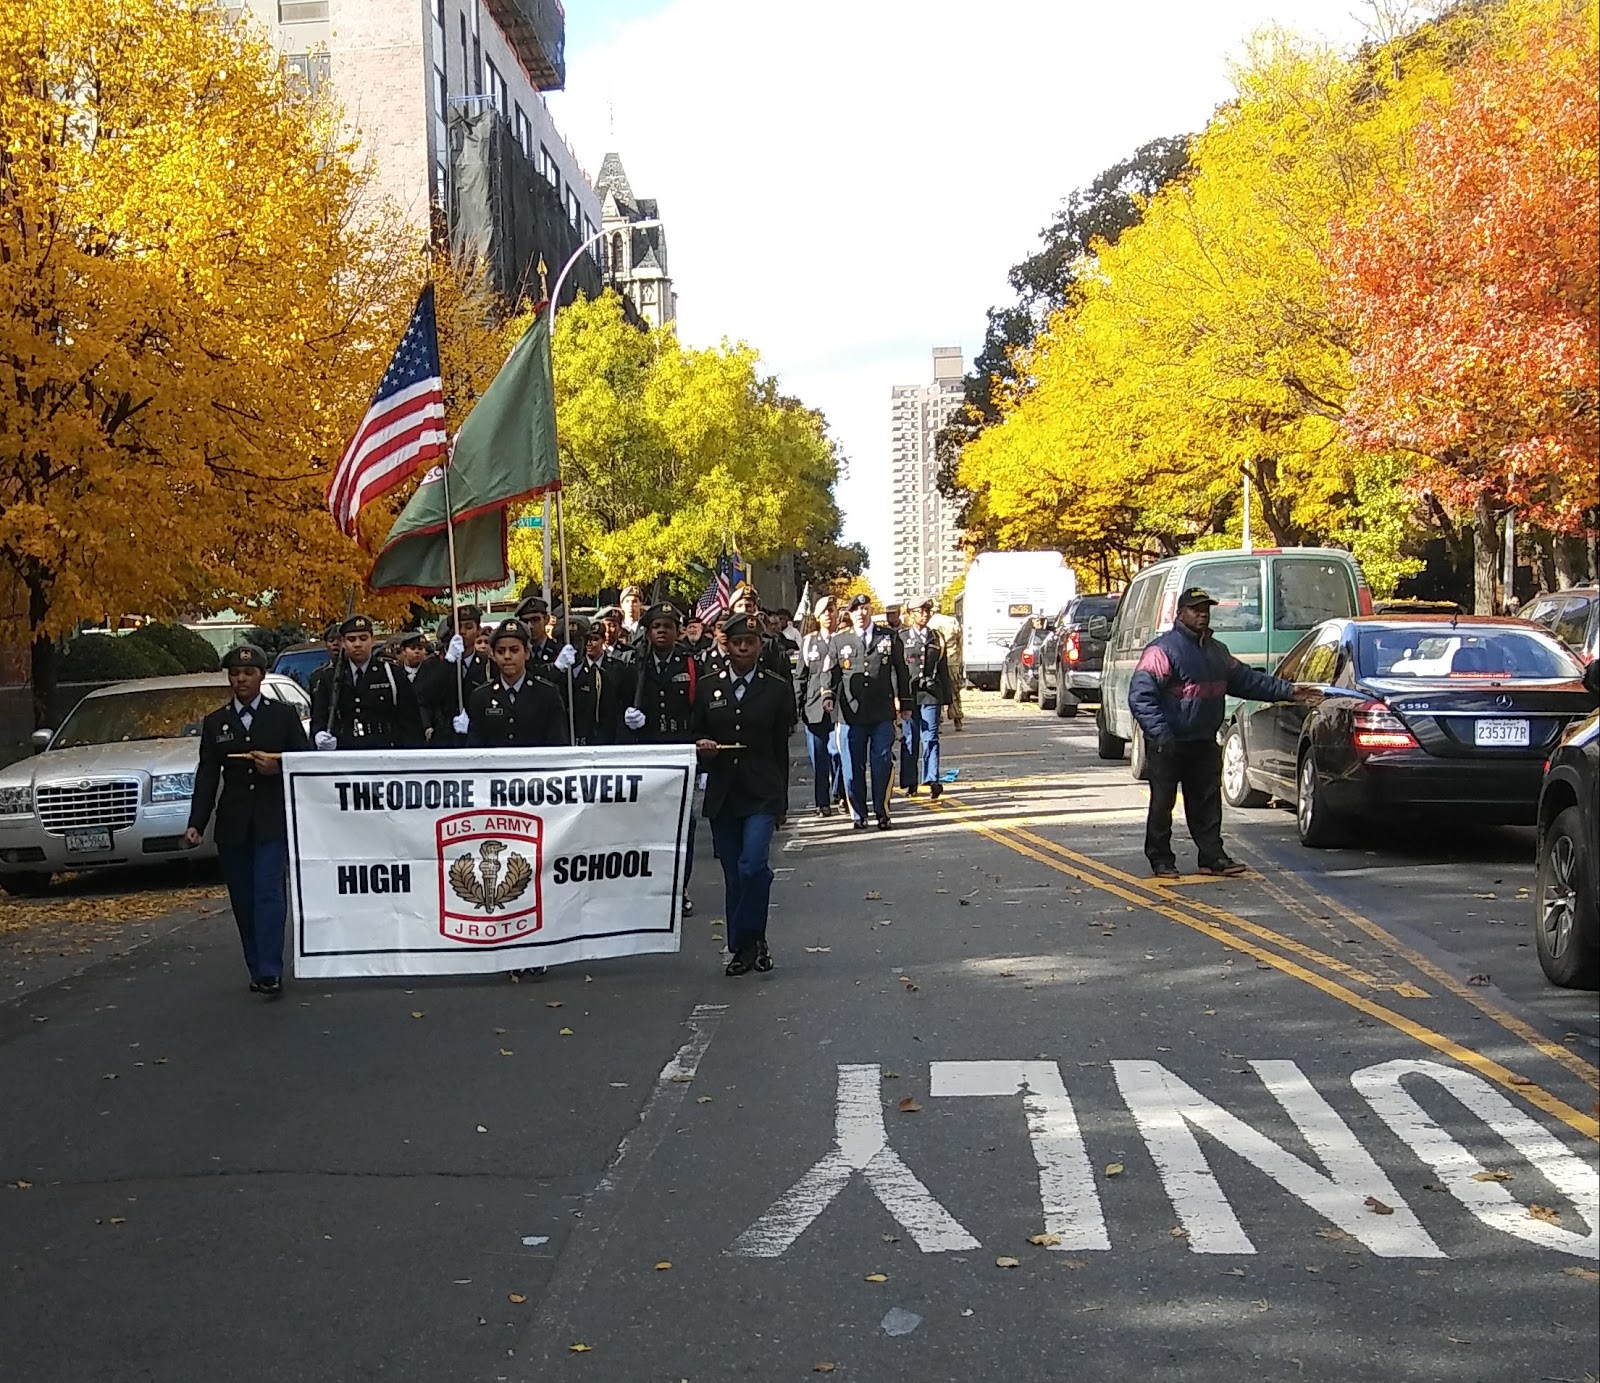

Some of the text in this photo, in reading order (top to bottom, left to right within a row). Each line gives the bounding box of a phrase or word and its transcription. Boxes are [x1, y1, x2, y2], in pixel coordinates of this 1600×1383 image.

[1478, 726, 1527, 740] 235377R
[334, 774, 643, 811] THEODORE ROOSEVELT
[446, 817, 532, 836] U.S. ARMY
[337, 863, 411, 895] HIGH
[553, 850, 653, 884] SCHOOL
[454, 918, 528, 937] JROTC
[720, 1058, 1600, 1261] ONLY
